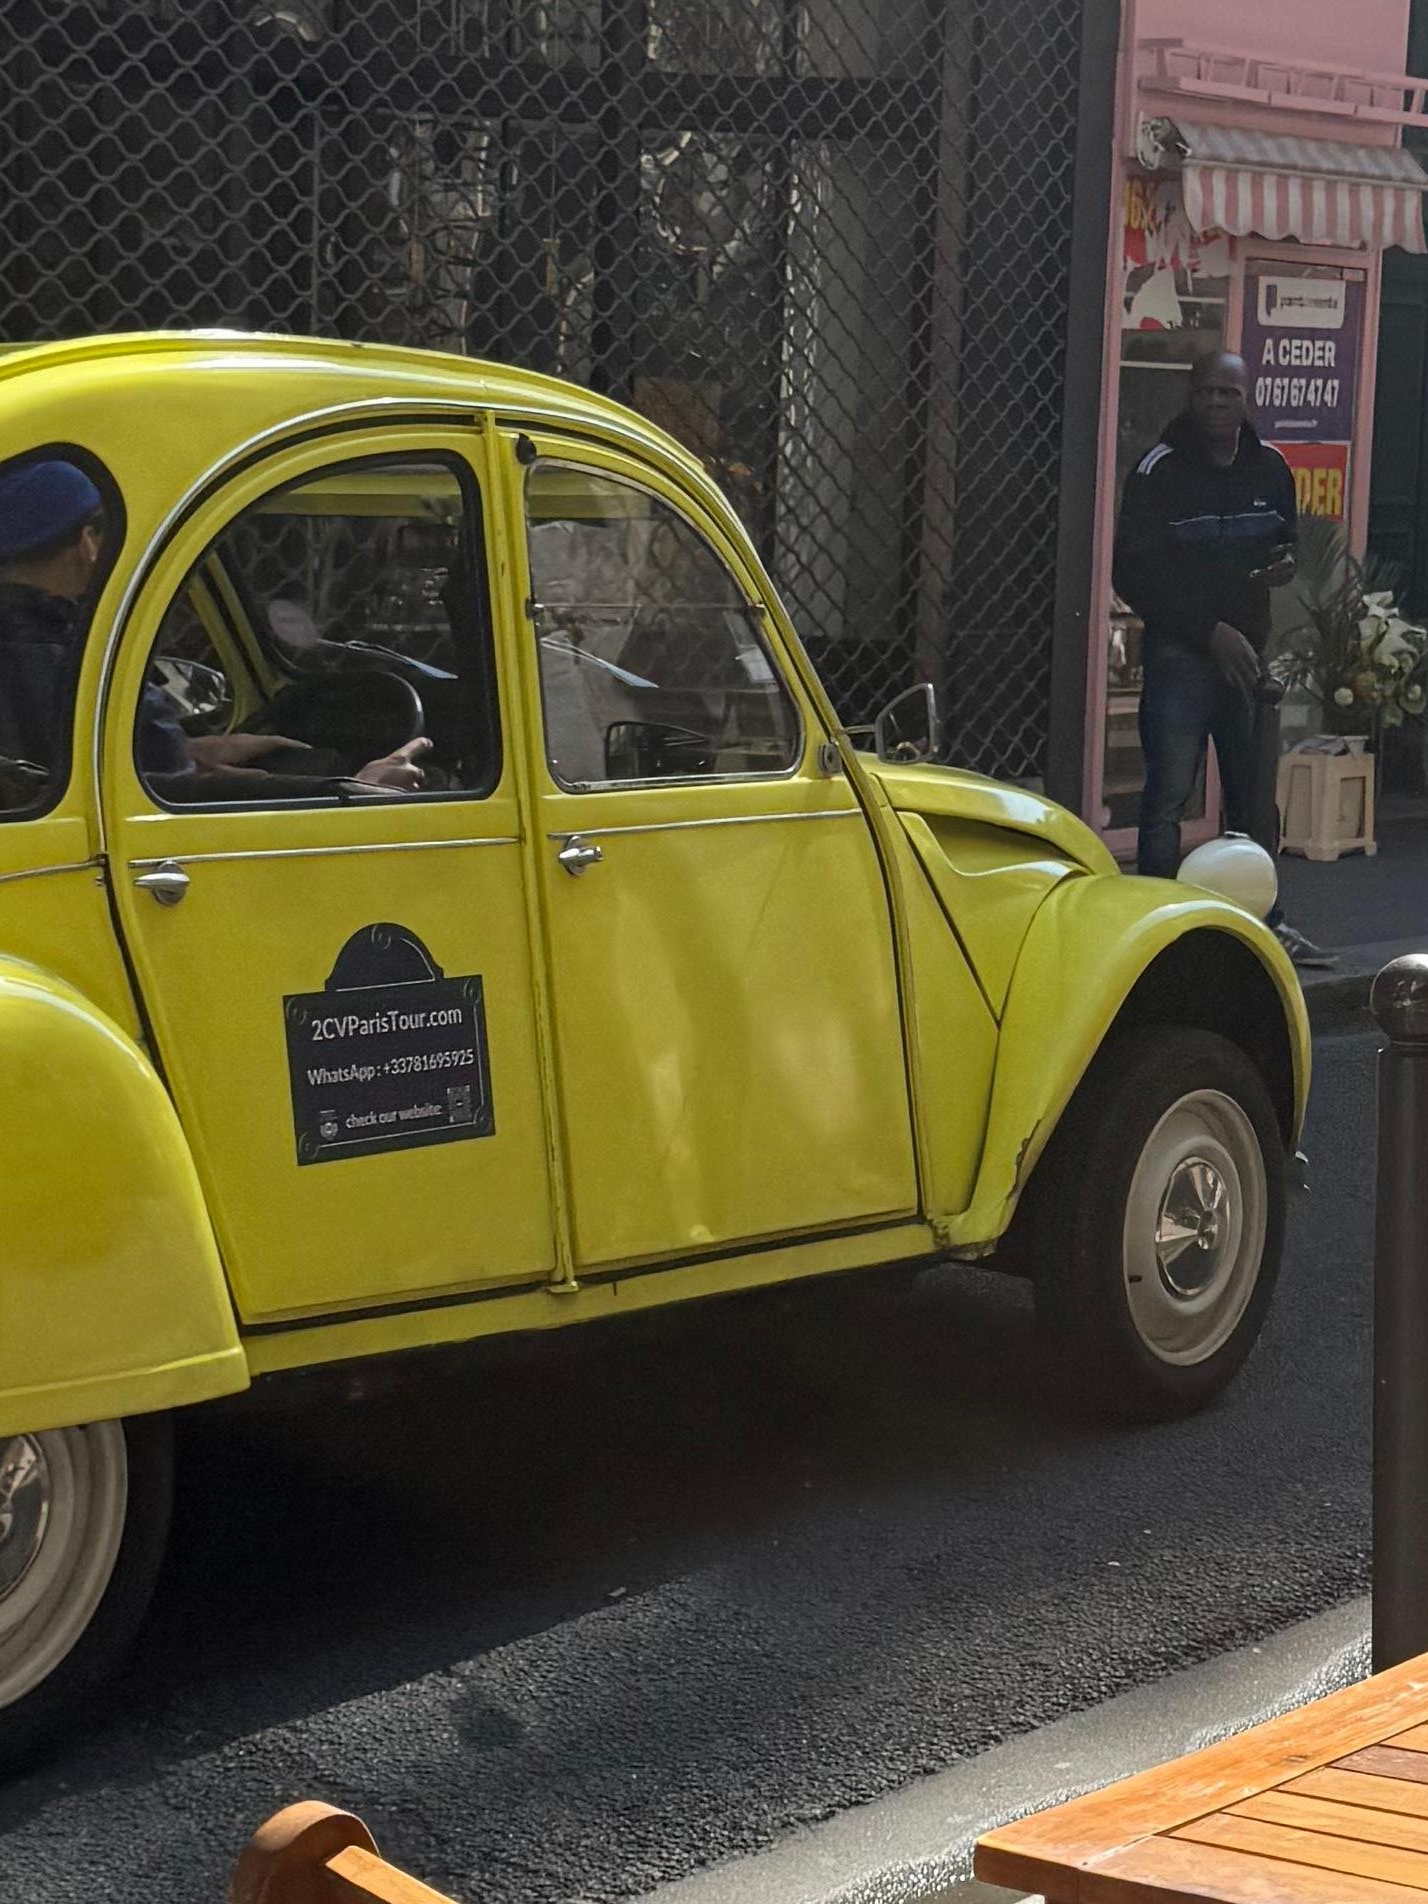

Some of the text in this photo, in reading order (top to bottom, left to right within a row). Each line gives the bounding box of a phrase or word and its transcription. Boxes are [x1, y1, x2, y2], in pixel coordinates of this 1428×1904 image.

[1261, 338, 1337, 367] A CEDER
[311, 1008, 463, 1041] 2CVParisTour.com
[345, 1111, 377, 1129] check
[378, 1110, 398, 1124] our
[398, 1102, 442, 1121] website
